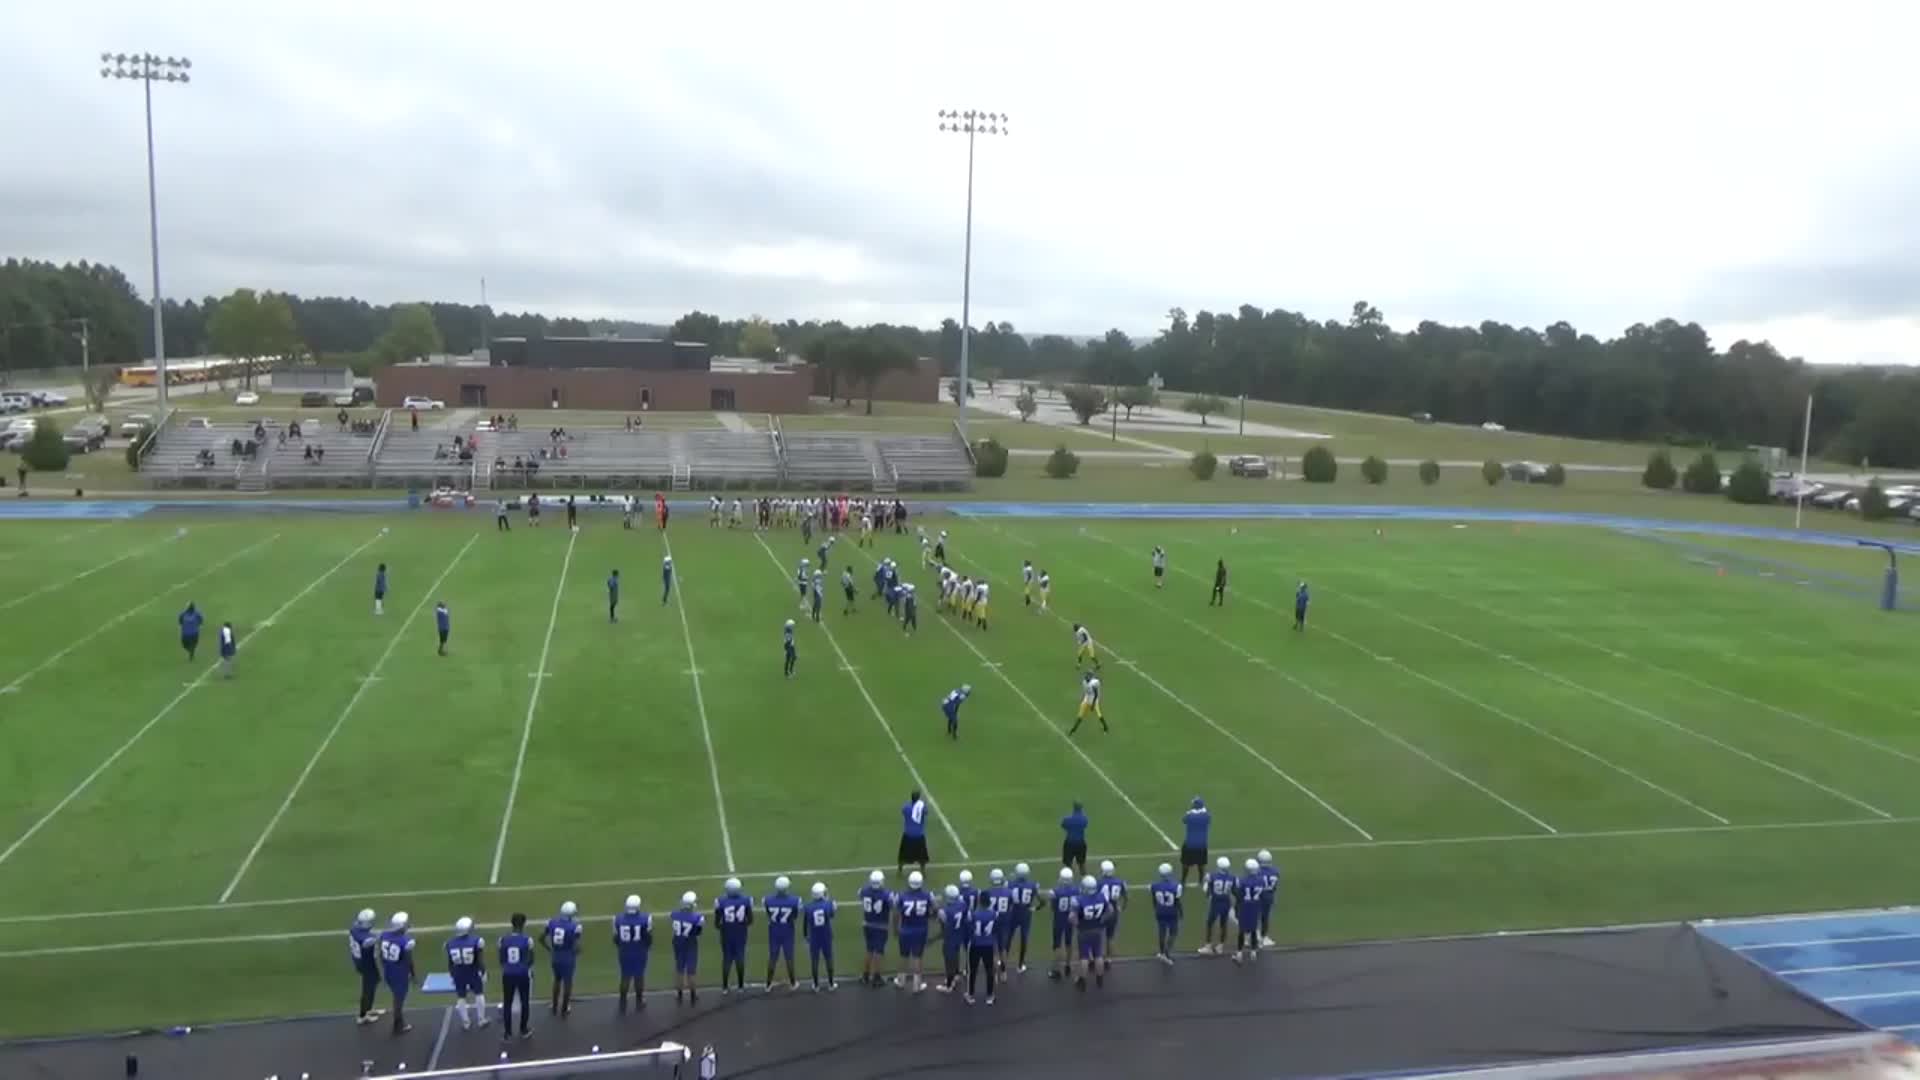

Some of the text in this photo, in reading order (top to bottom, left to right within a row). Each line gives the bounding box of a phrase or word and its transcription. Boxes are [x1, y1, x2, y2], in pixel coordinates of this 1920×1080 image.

[768, 907, 793, 924] 77
[903, 900, 928, 917] 75
[552, 926, 565, 944] 2
[974, 919, 994, 937] 14
[450, 946, 475, 965] 25
